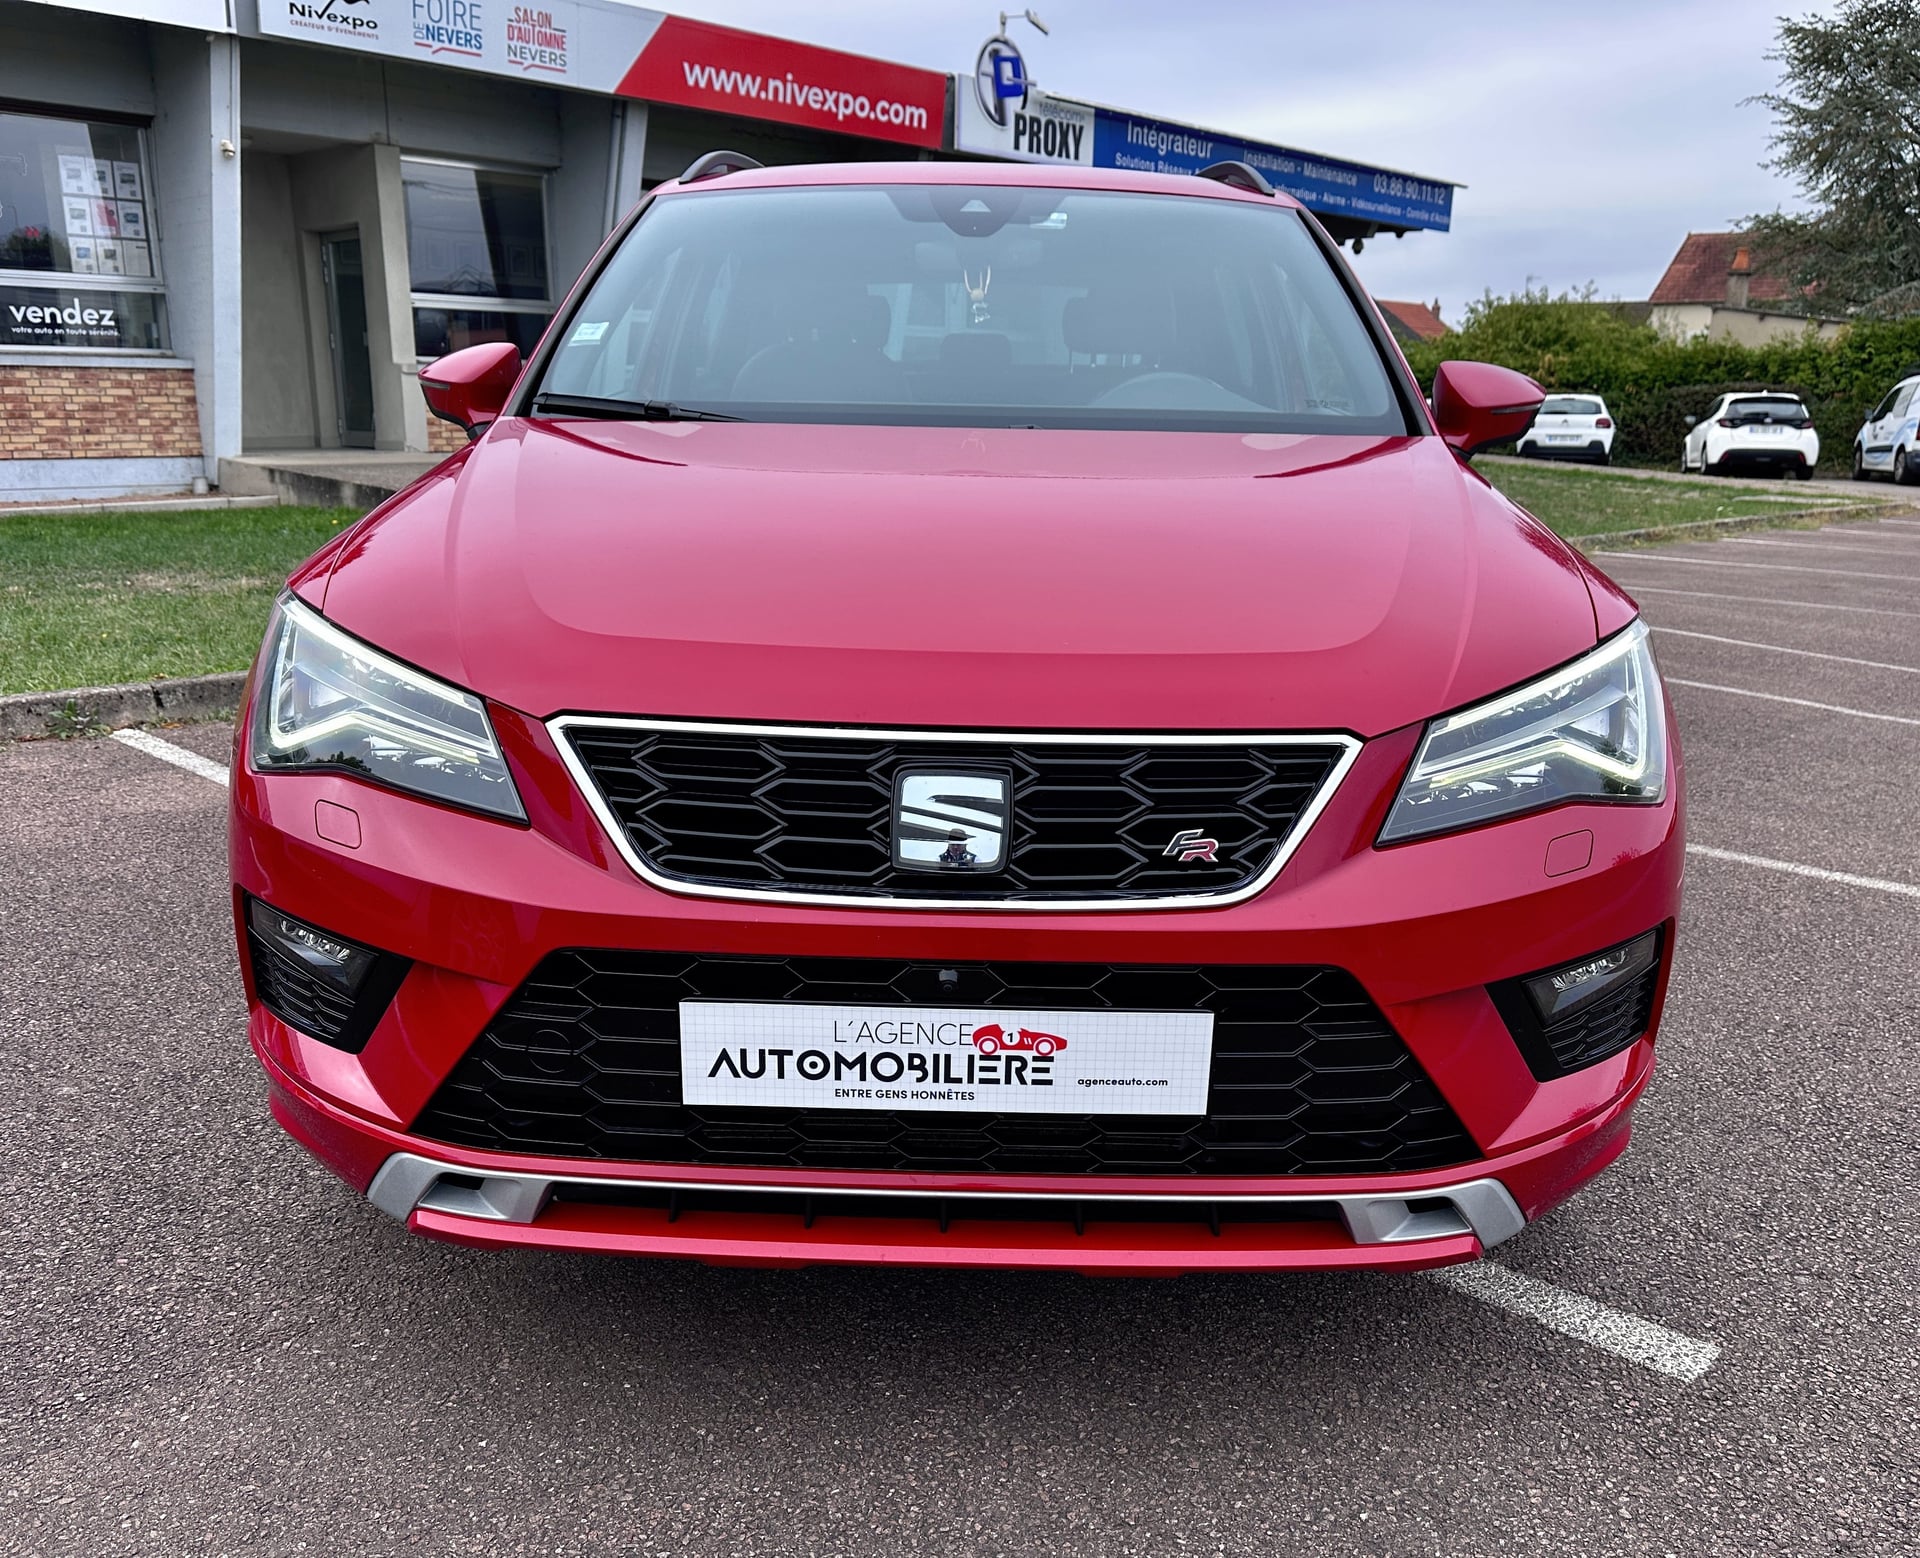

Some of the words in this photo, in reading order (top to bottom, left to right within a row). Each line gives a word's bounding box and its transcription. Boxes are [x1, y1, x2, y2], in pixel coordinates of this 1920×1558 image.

[289, 0, 378, 29] Nivexpo
[412, 0, 482, 31] FOIRE
[514, 6, 552, 28] SALON
[413, 22, 425, 40] DE
[426, 24, 482, 50] NEVERS
[507, 24, 566, 51] D'AUTOMNE
[507, 44, 567, 67] NEVERS
[683, 61, 928, 130] www.nivexpo.com
[1013, 110, 1084, 161] PROXY
[1127, 119, 1213, 160] Intégrateur
[1115, 152, 1156, 172] Solutions
[1243, 149, 1296, 174] Installation
[1303, 161, 1358, 187] Maintenance
[1373, 173, 1446, 205] 03.86.90.11.12
[8, 297, 116, 327] vendez
[11, 326, 33, 334] votre
[34, 327, 53, 335] auto
[66, 328, 87, 336] toute
[1162, 828, 1219, 862] FR
[834, 1020, 973, 1046] L'AGENCE
[834, 1088, 872, 1098] ENTRE
[875, 1089, 908, 1099] GENS
[911, 1089, 975, 1101] HONNÊTES
[1077, 1077, 1169, 1088] agenceauto.com
